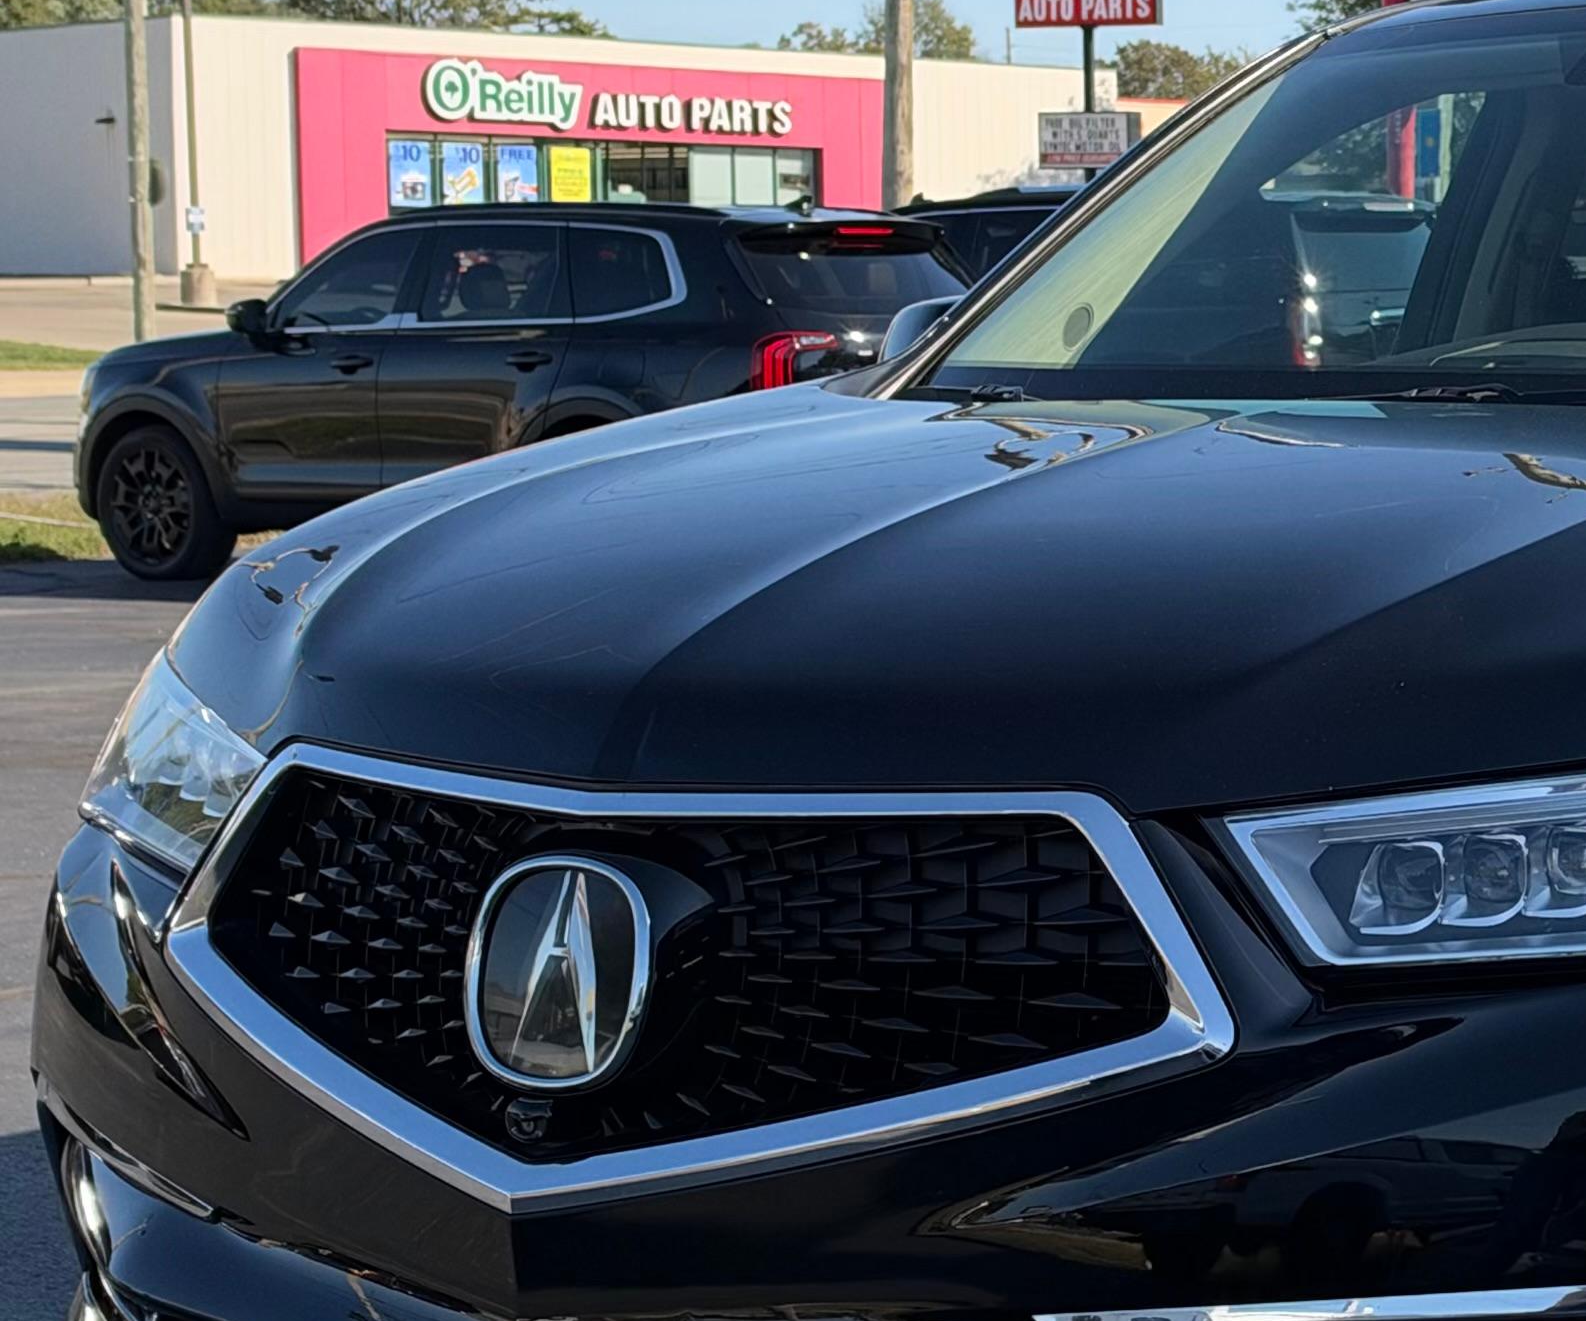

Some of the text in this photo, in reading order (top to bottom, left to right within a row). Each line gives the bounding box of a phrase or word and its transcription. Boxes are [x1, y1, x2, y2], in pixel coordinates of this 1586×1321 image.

[430, 63, 793, 135] O'Reilly AUTO PARTS
